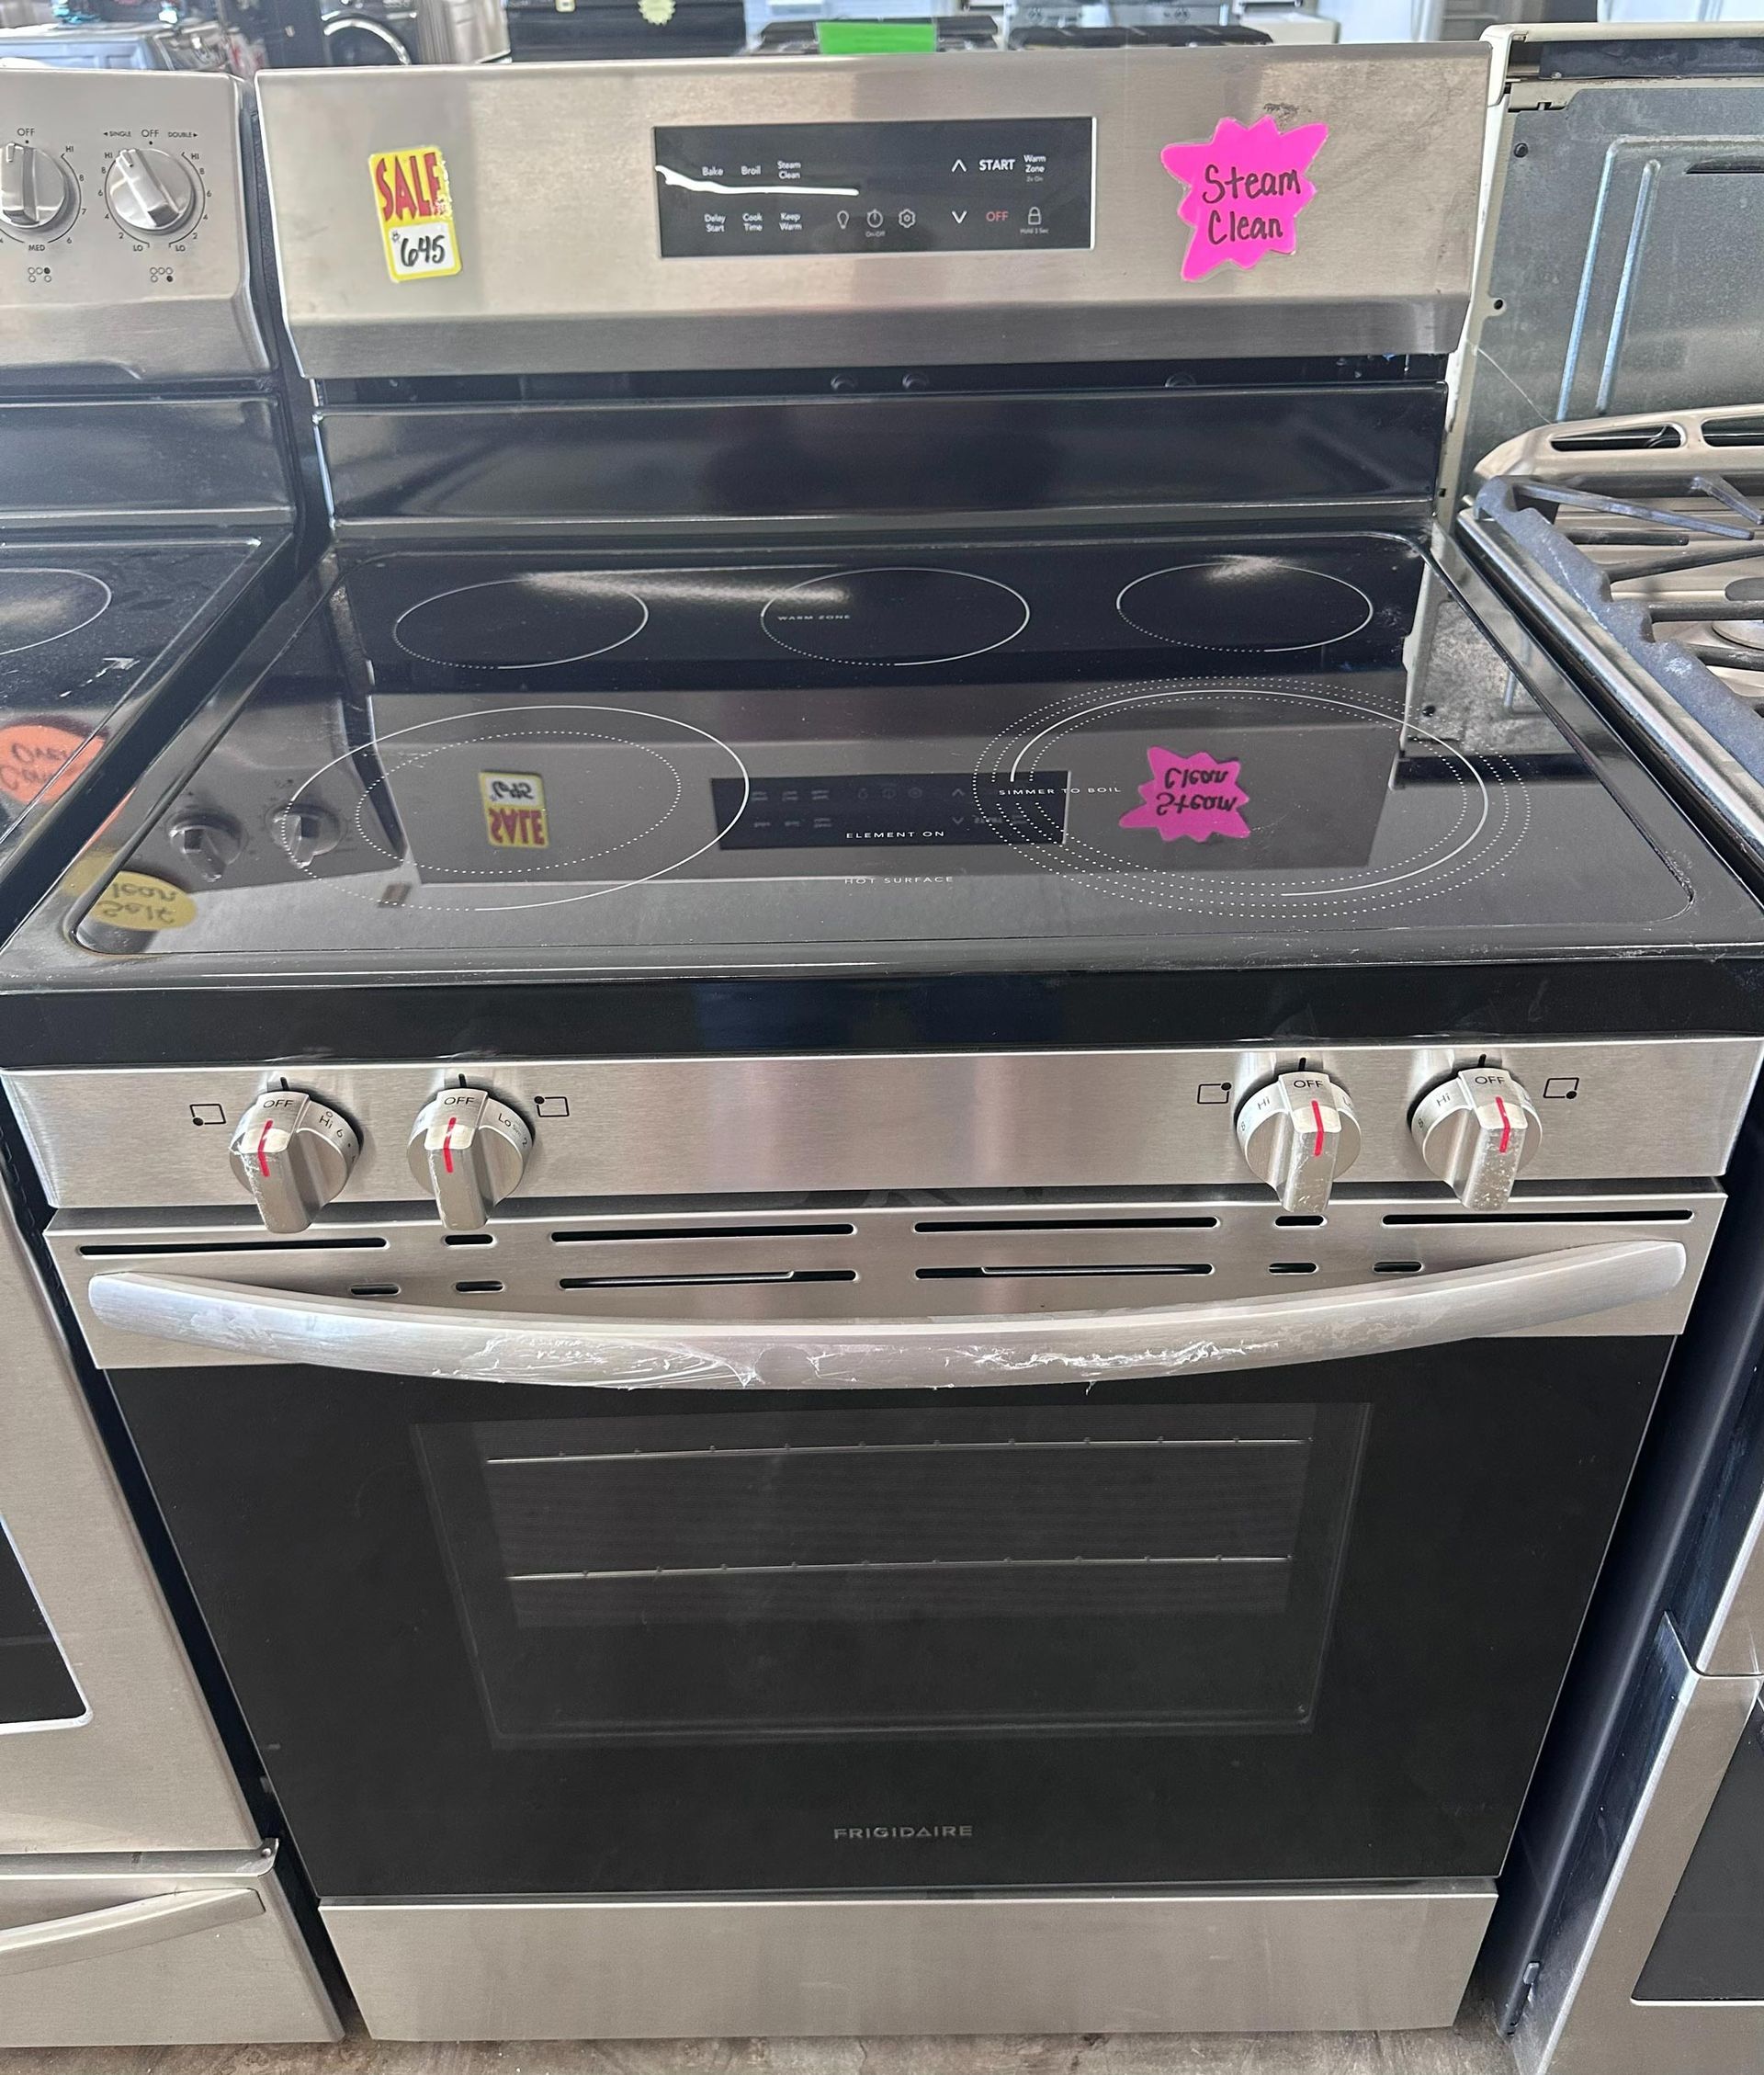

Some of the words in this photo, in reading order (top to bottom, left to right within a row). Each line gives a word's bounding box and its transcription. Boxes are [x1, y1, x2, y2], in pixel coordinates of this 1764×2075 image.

[17, 128, 36, 137] OFF
[141, 129, 160, 138] OFF
[65, 145, 75, 153] HI
[1023, 154, 1047, 163] Warm
[776, 160, 802, 170] Steam
[978, 158, 1016, 171] START
[1024, 164, 1046, 173] Zone
[701, 165, 724, 176] Bake
[741, 164, 762, 176] Broil
[778, 170, 801, 179] Clean
[375, 152, 444, 221] SALE
[1202, 164, 1301, 204] Steam
[704, 212, 727, 223] Delay
[741, 212, 763, 221] Cook
[780, 212, 801, 222] Keep
[985, 210, 1009, 221] OFF
[705, 223, 725, 232] Start
[743, 222, 763, 232] Time
[778, 222, 802, 231] Warm
[1207, 210, 1283, 245] Clean
[846, 831, 916, 839] ELEMENT
[884, 876, 955, 884] SURFACE
[1293, 1079, 1324, 1089] OFF
[1474, 1075, 1506, 1085] OFF
[263, 1099, 295, 1108] OFF
[444, 1095, 476, 1106] OFF
[1257, 1095, 1270, 1110] Hi
[1436, 1092, 1451, 1106] Hi
[319, 1115, 333, 1128] Hi
[498, 1112, 512, 1128] Lo
[833, 1825, 974, 1840] FRIGIDAIRE
